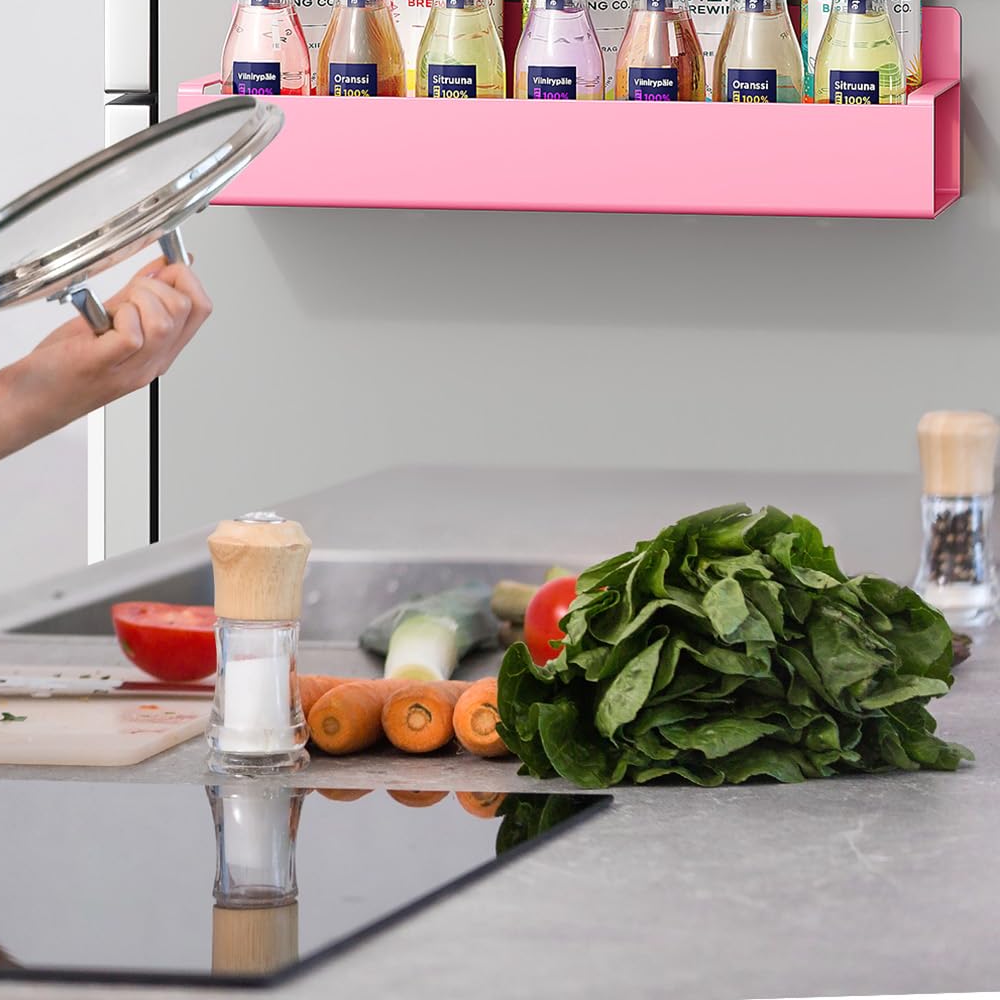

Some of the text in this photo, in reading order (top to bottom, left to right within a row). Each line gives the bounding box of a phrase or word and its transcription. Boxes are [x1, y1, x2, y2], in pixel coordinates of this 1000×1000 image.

[612, 0, 631, 10] CO.
[893, 3, 912, 13] CO.
[334, 74, 369, 85] Oranssi
[432, 75, 473, 85] Sitruuna
[732, 79, 769, 90] Oranssi
[834, 80, 876, 91] Sitruuna
[247, 87, 273, 96] 100%
[343, 89, 370, 97] 100%
[441, 90, 469, 98] 100%
[543, 91, 569, 100] 100%
[643, 93, 671, 102] 100%
[741, 95, 769, 103] 100%
[843, 96, 871, 105] 100%
